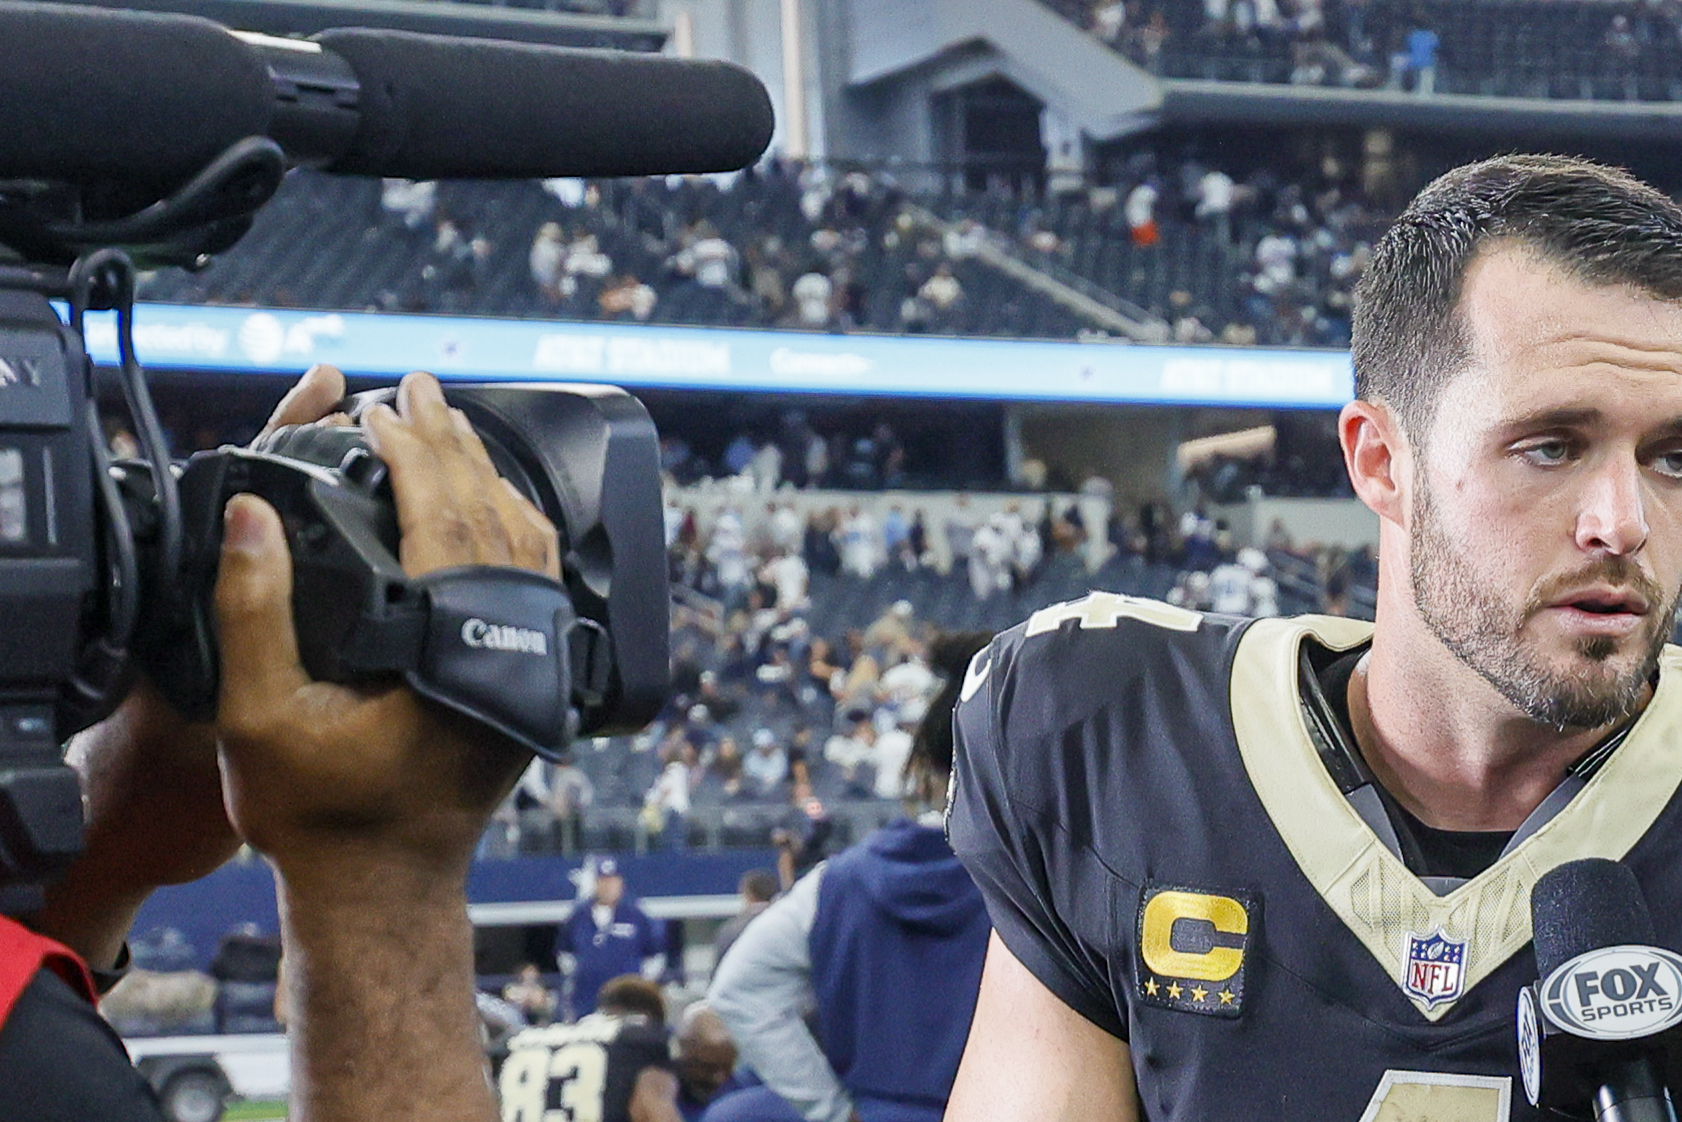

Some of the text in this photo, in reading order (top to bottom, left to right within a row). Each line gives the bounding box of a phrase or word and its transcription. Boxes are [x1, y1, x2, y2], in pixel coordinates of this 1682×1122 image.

[461, 617, 547, 656] Canon
[1142, 890, 1249, 981] C
[1410, 962, 1454, 995] NFL
[1574, 961, 1669, 1008] FOX
[1580, 996, 1674, 1022] SPORTS
